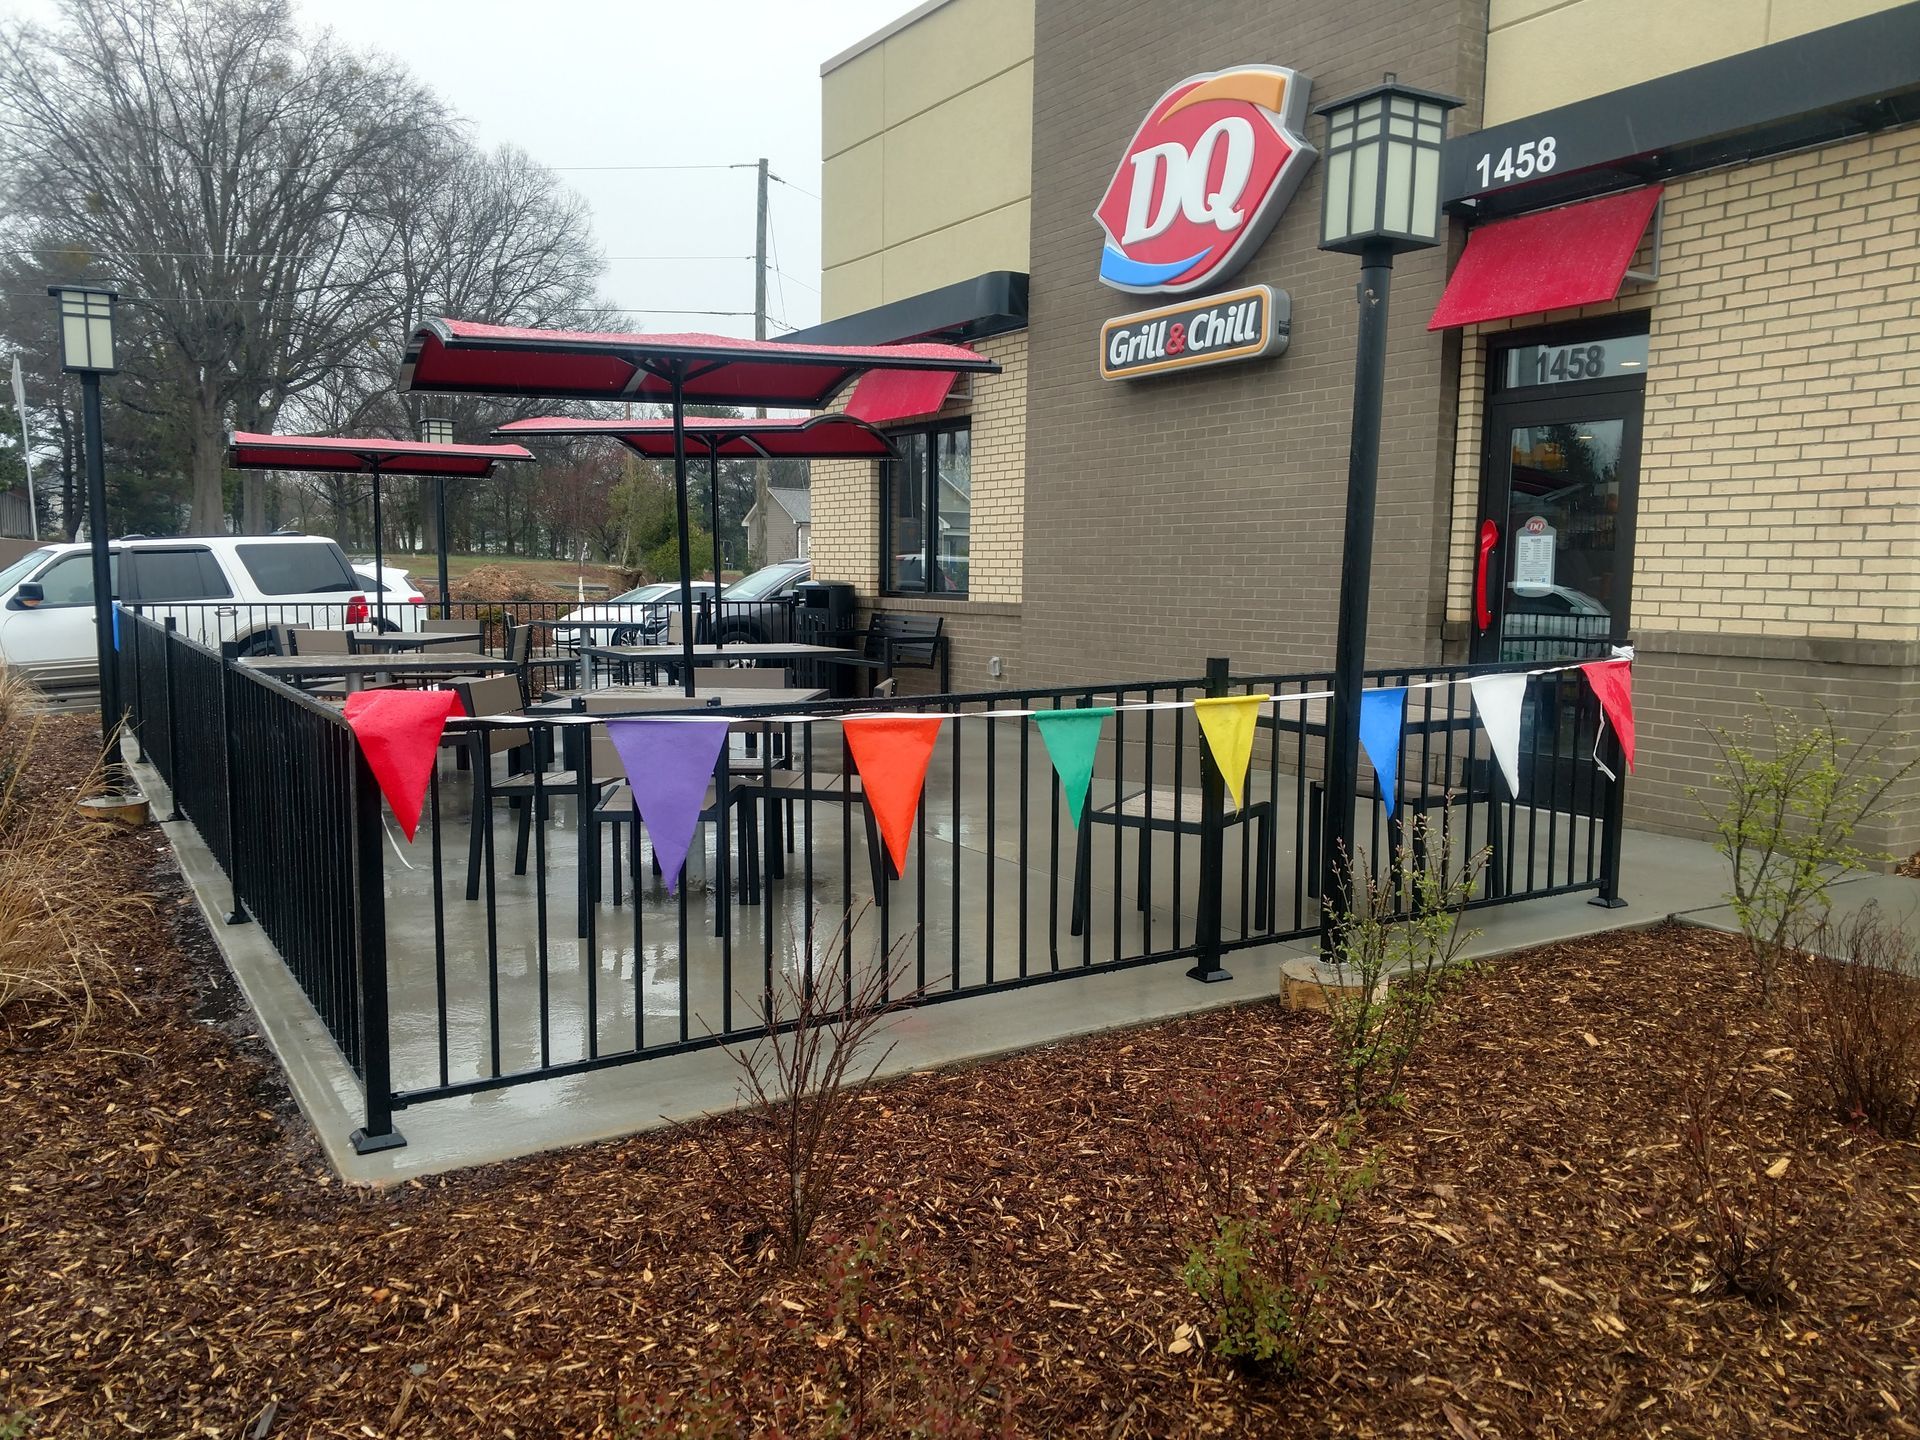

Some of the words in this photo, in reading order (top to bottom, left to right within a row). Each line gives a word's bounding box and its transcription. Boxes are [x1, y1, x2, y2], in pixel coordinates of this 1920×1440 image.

[1122, 117, 1255, 245] DQ
[1476, 136, 1557, 188] 1458
[1536, 345, 1605, 382] 1458
[1530, 522, 1544, 531] DQ
